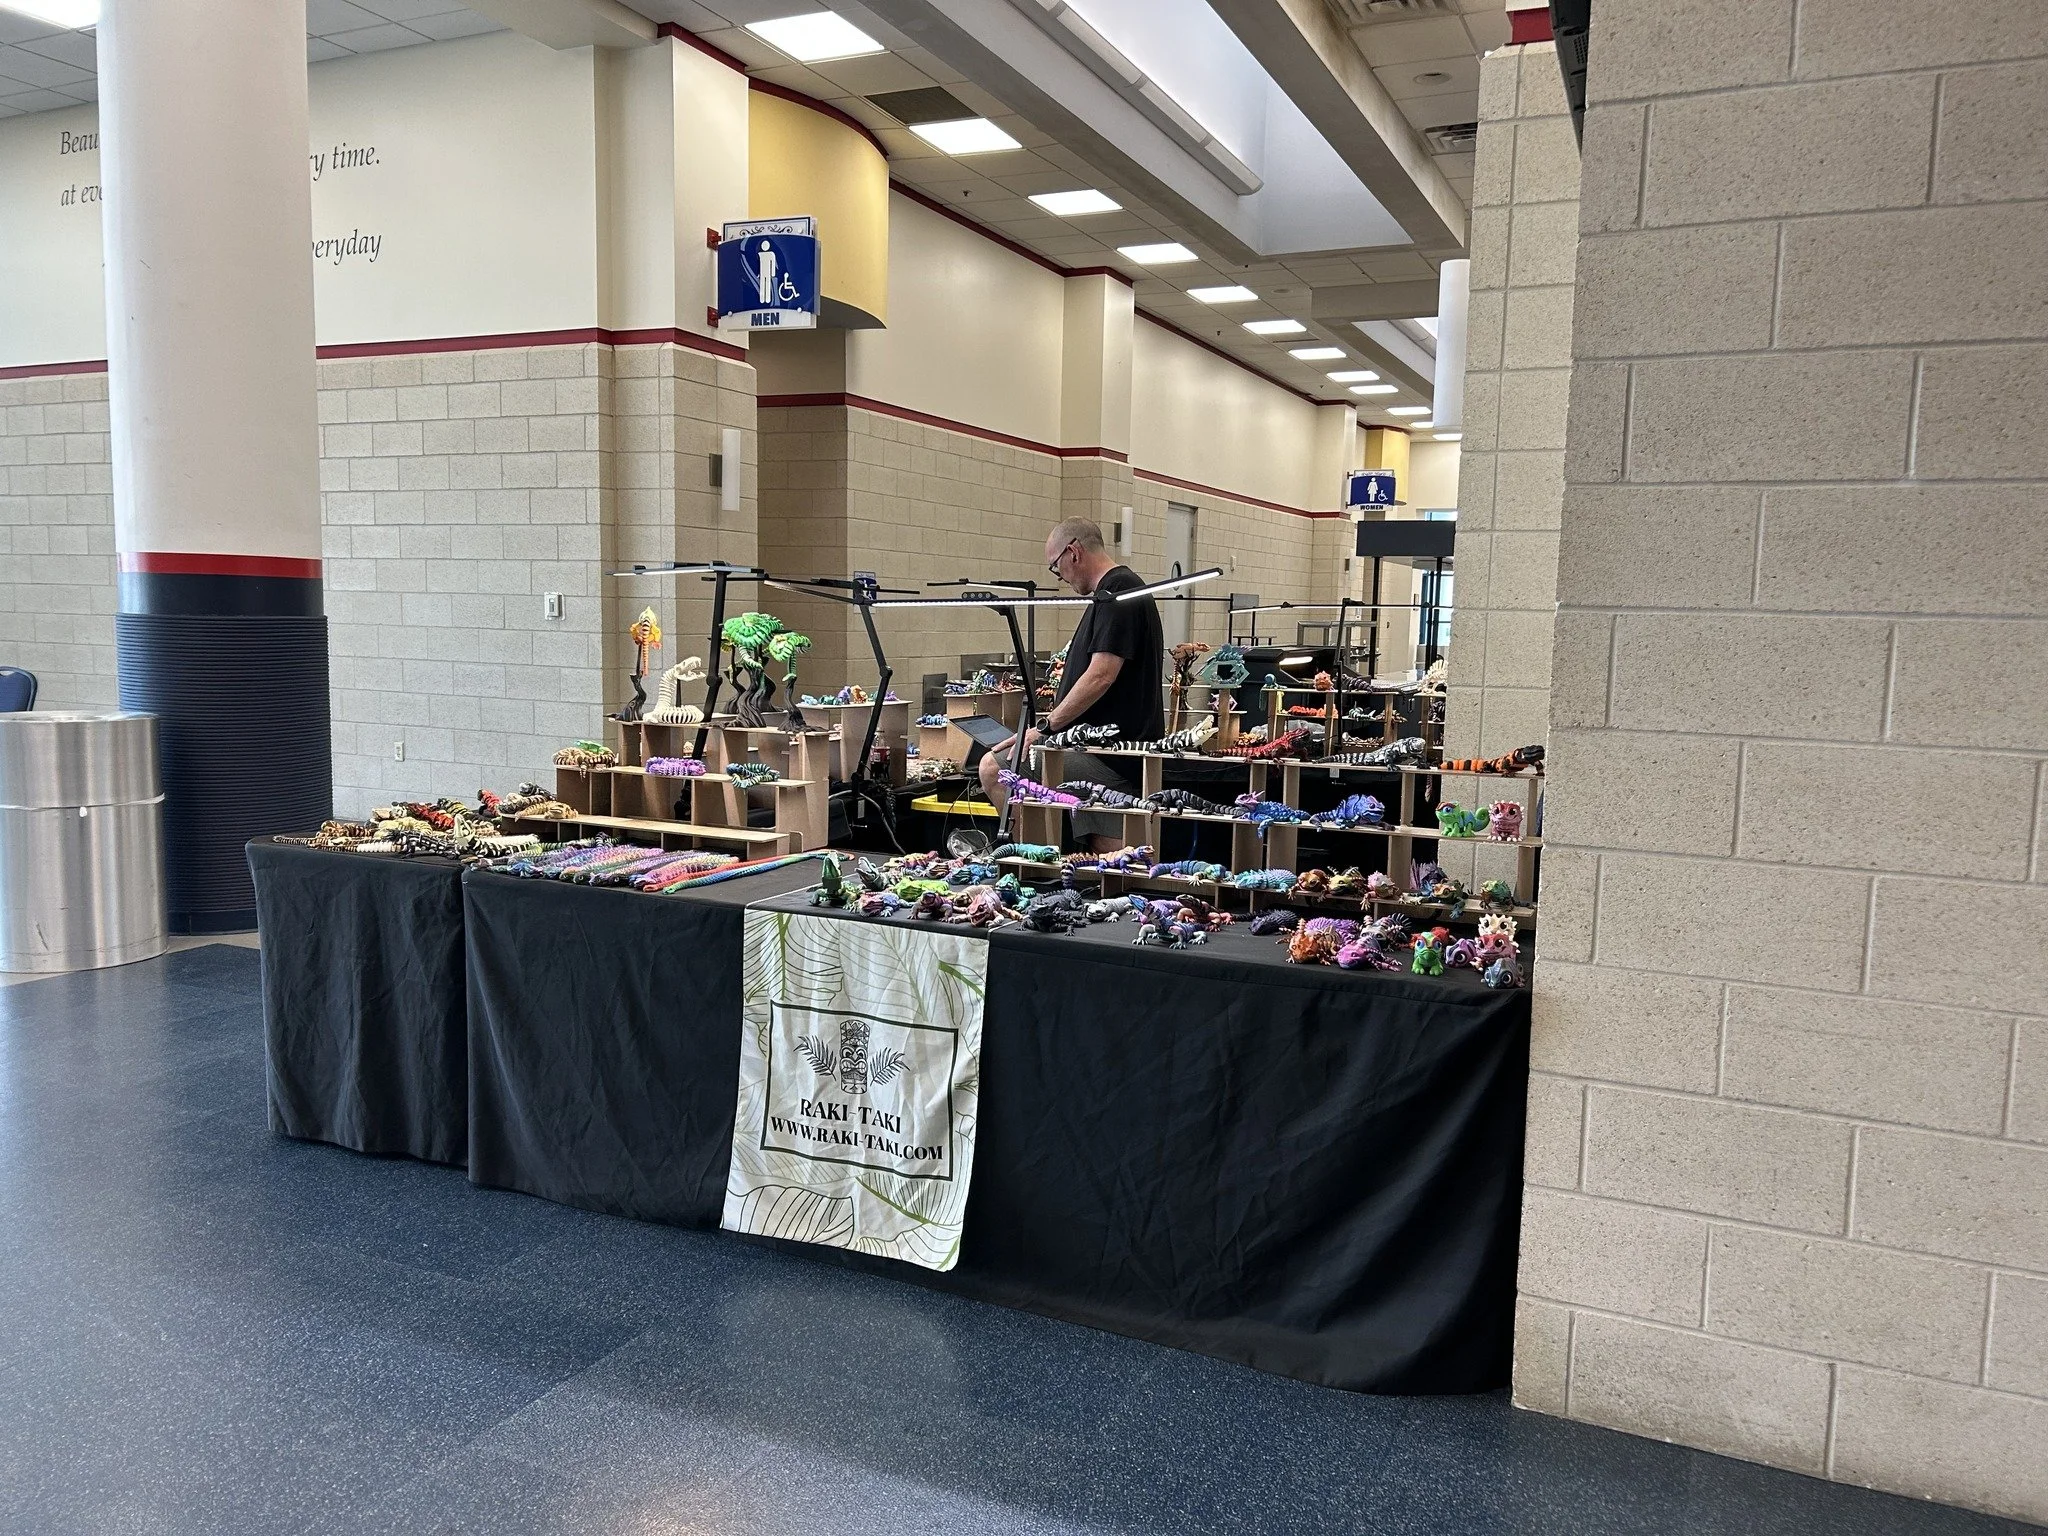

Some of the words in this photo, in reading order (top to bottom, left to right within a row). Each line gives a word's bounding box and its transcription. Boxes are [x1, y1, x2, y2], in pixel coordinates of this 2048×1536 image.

[61, 184, 76, 206] at
[309, 153, 325, 181] y
[333, 142, 380, 169] time.
[312, 228, 382, 265] eryday
[750, 312, 780, 327] MEN
[770, 1116, 943, 1160] WWW.RAKI-TAKI.COM
